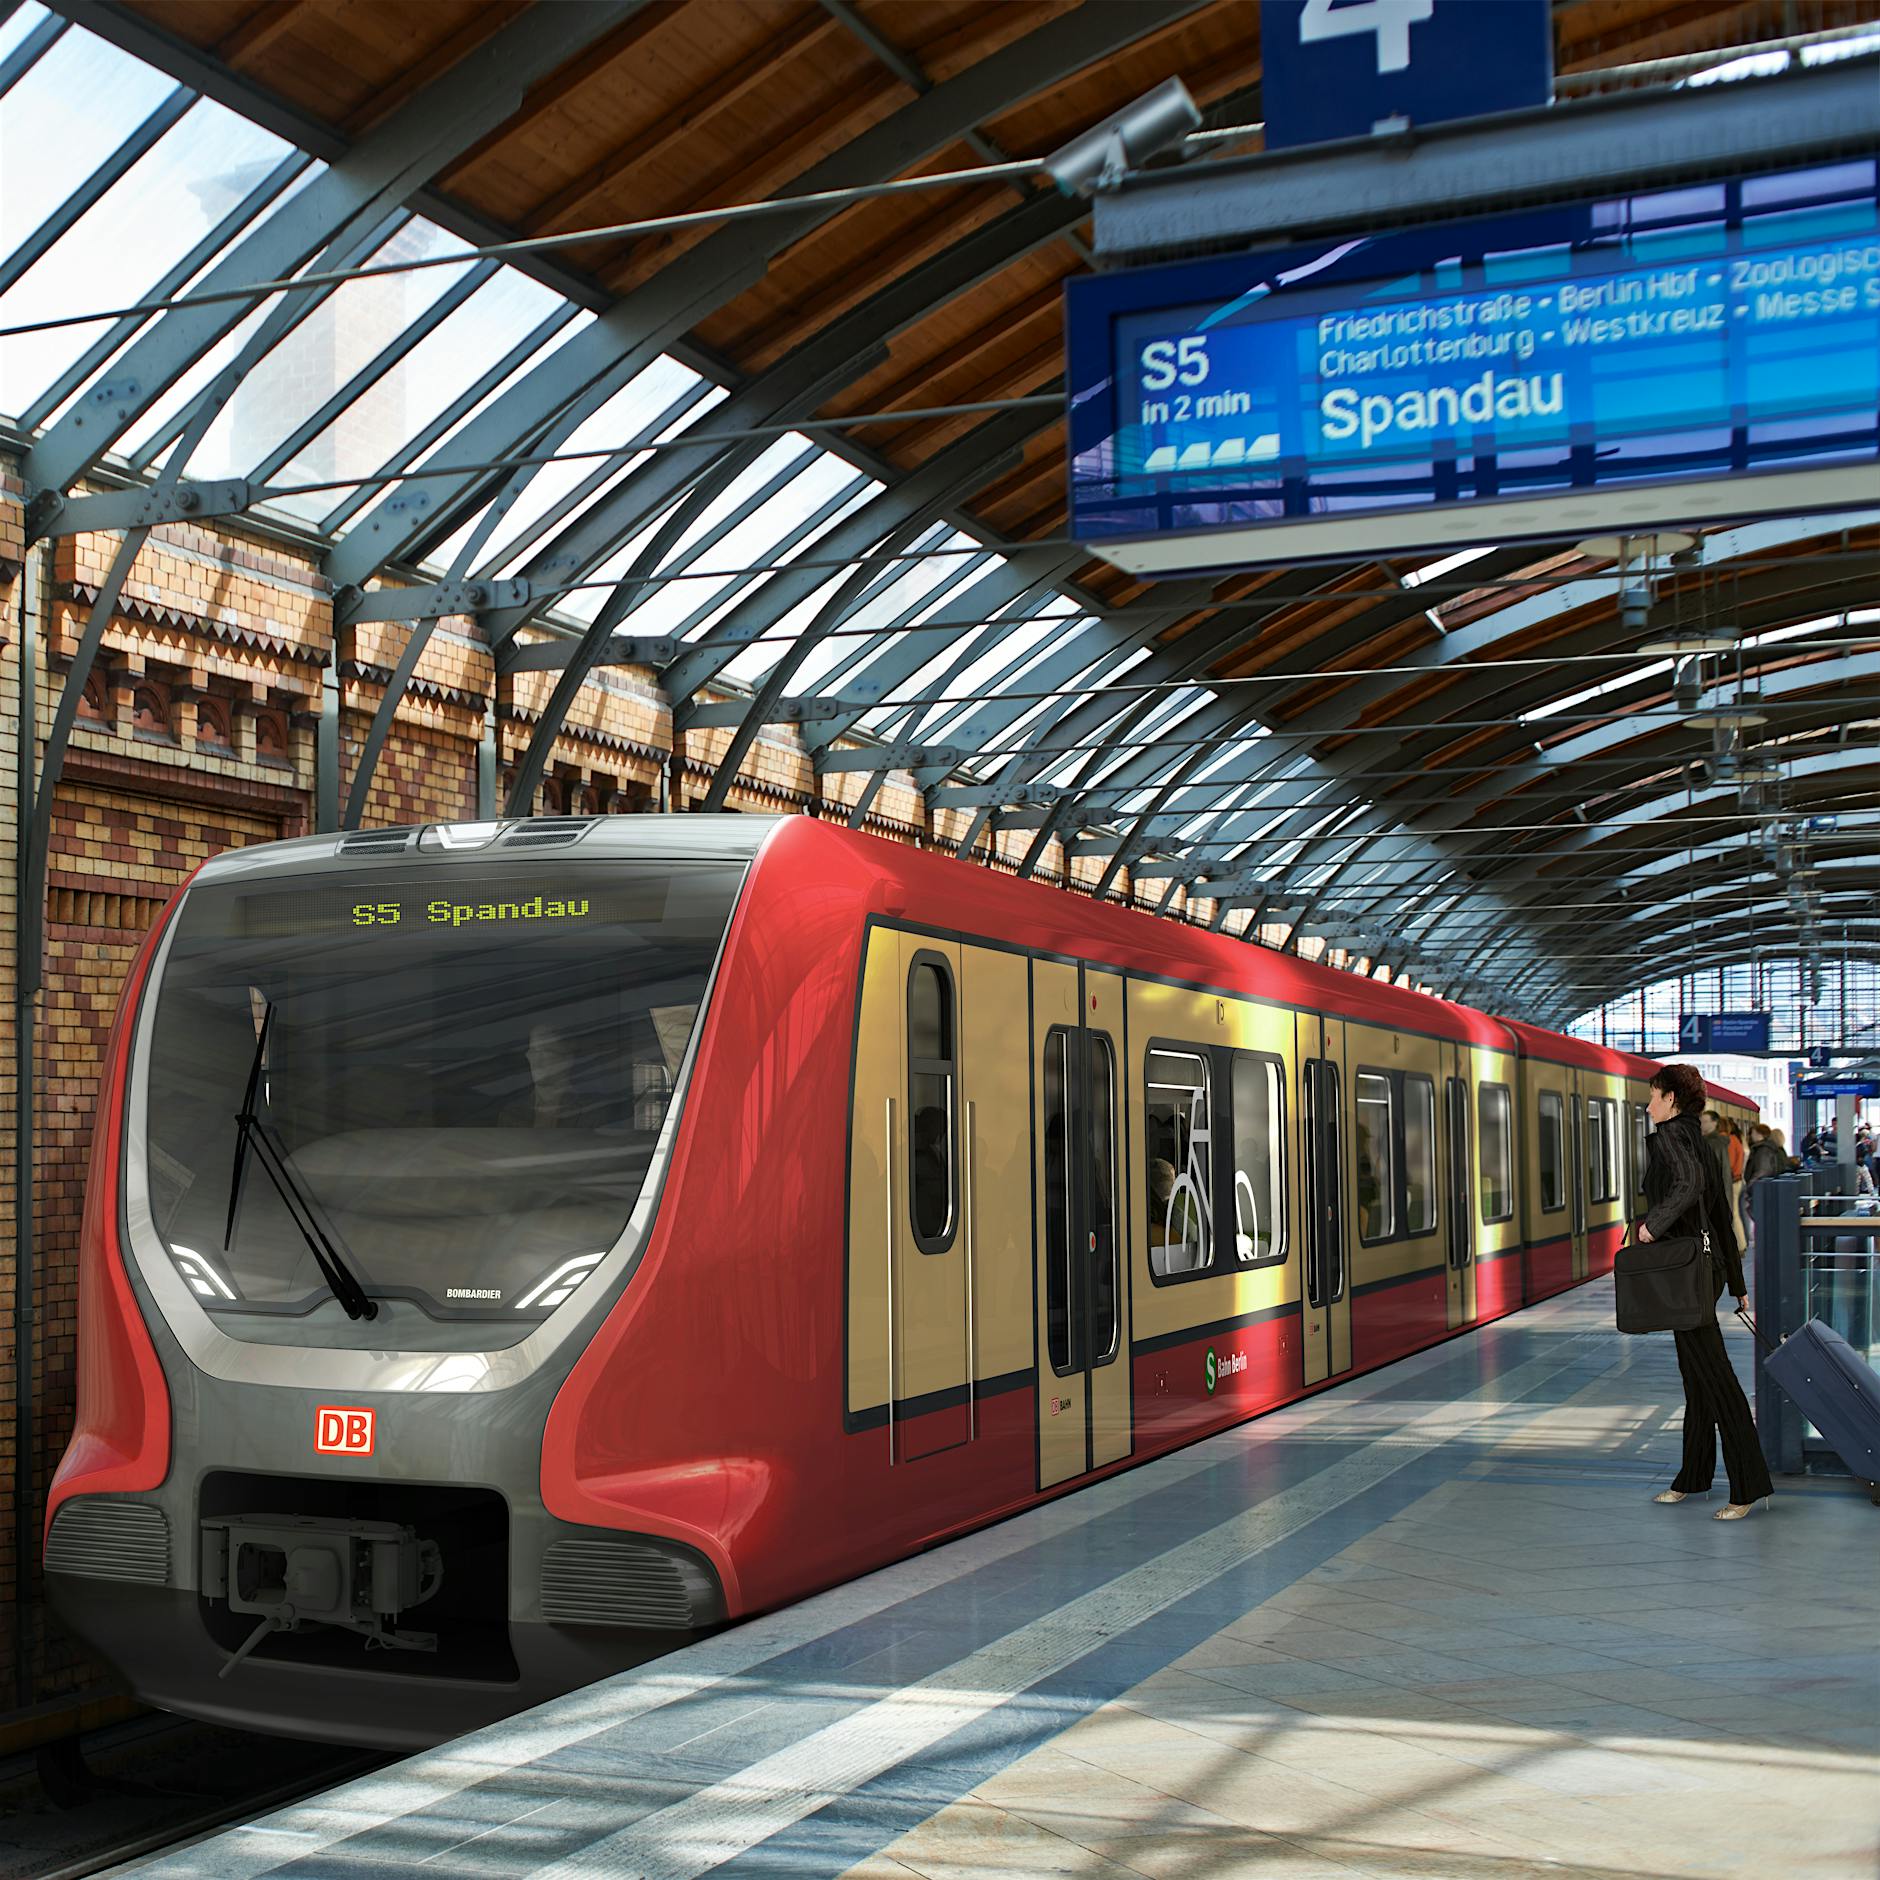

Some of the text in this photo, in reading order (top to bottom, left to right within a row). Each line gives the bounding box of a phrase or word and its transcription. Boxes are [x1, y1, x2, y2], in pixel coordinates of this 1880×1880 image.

[1319, 294, 1532, 345] Friedrichstraße
[1558, 276, 1642, 314] Berlin
[1647, 268, 1699, 299] Hbf
[1320, 328, 1535, 378] Charlottenburg
[1562, 303, 1725, 346] Westkreuz
[1756, 286, 1858, 322] Messe
[1141, 335, 1210, 391] S5
[1141, 389, 1251, 425] in 2 min
[1321, 370, 1564, 449] Spandau
[352, 896, 589, 927] S5 Spandau
[1681, 1016, 1703, 1044] 4
[446, 1288, 501, 1300] BOMBARDIER
[321, 1413, 368, 1448] DB
